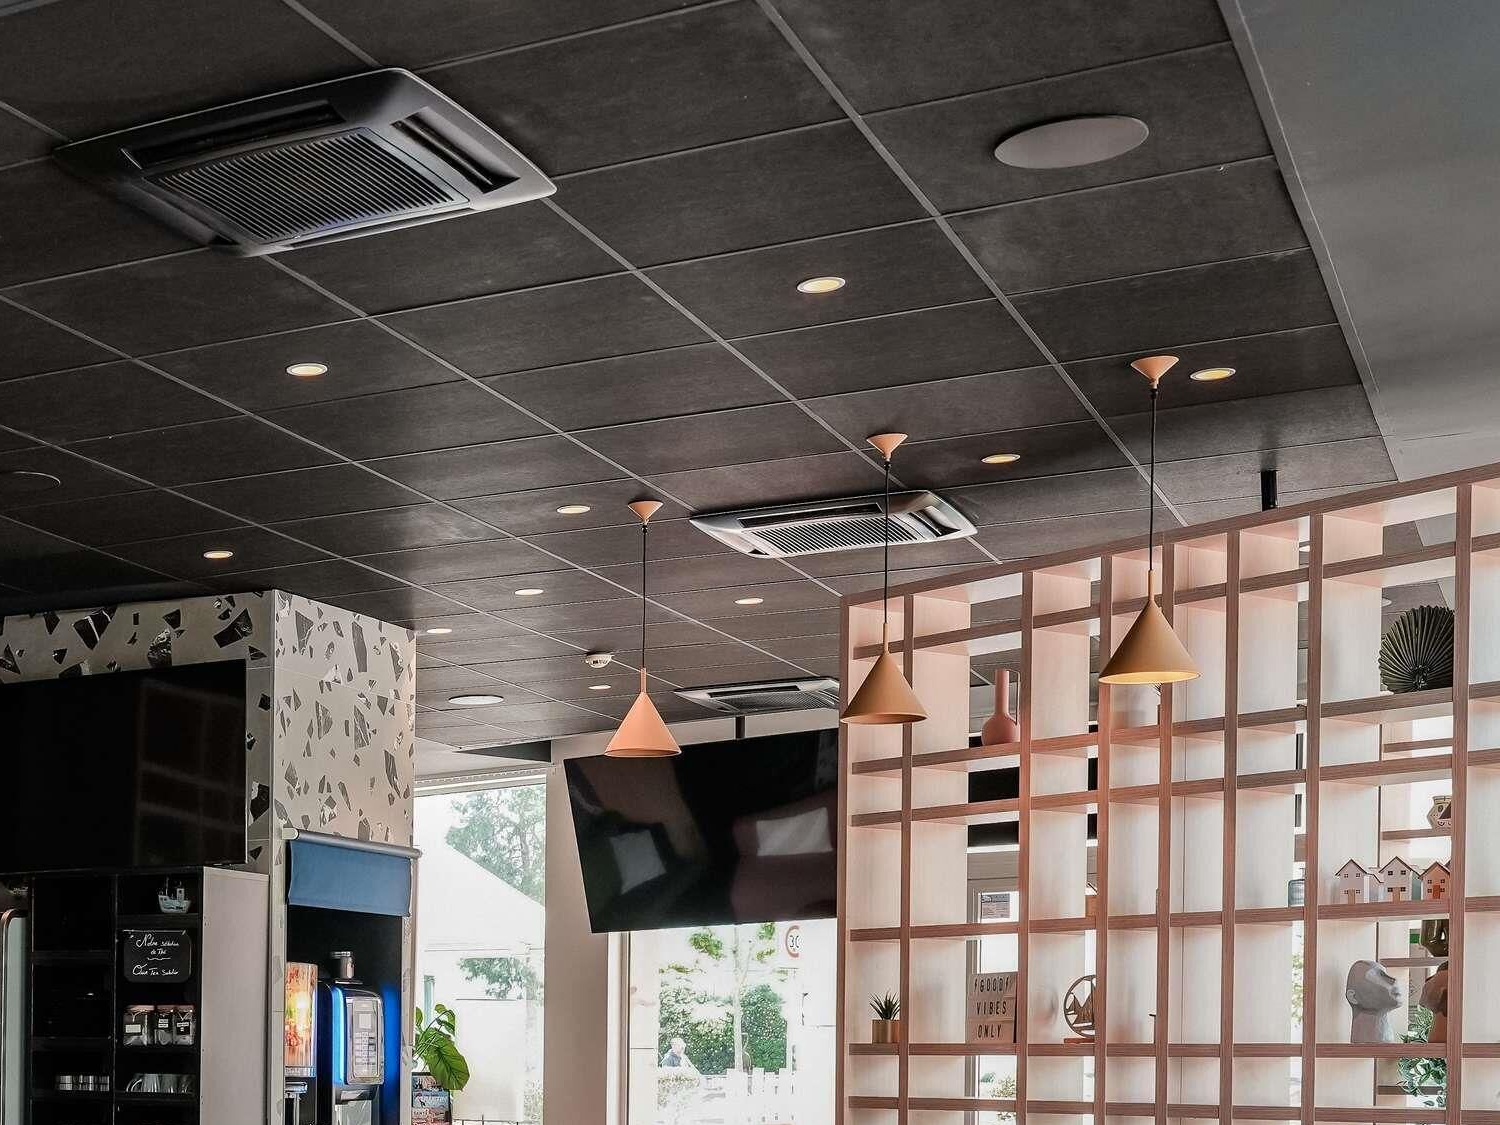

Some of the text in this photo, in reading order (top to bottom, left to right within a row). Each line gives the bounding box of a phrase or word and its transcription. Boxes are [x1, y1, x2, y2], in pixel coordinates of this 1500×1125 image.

[980, 978, 1003, 992] GOOD
[976, 1001, 1007, 1015] VIBES
[977, 1024, 1002, 1038] ONLY
